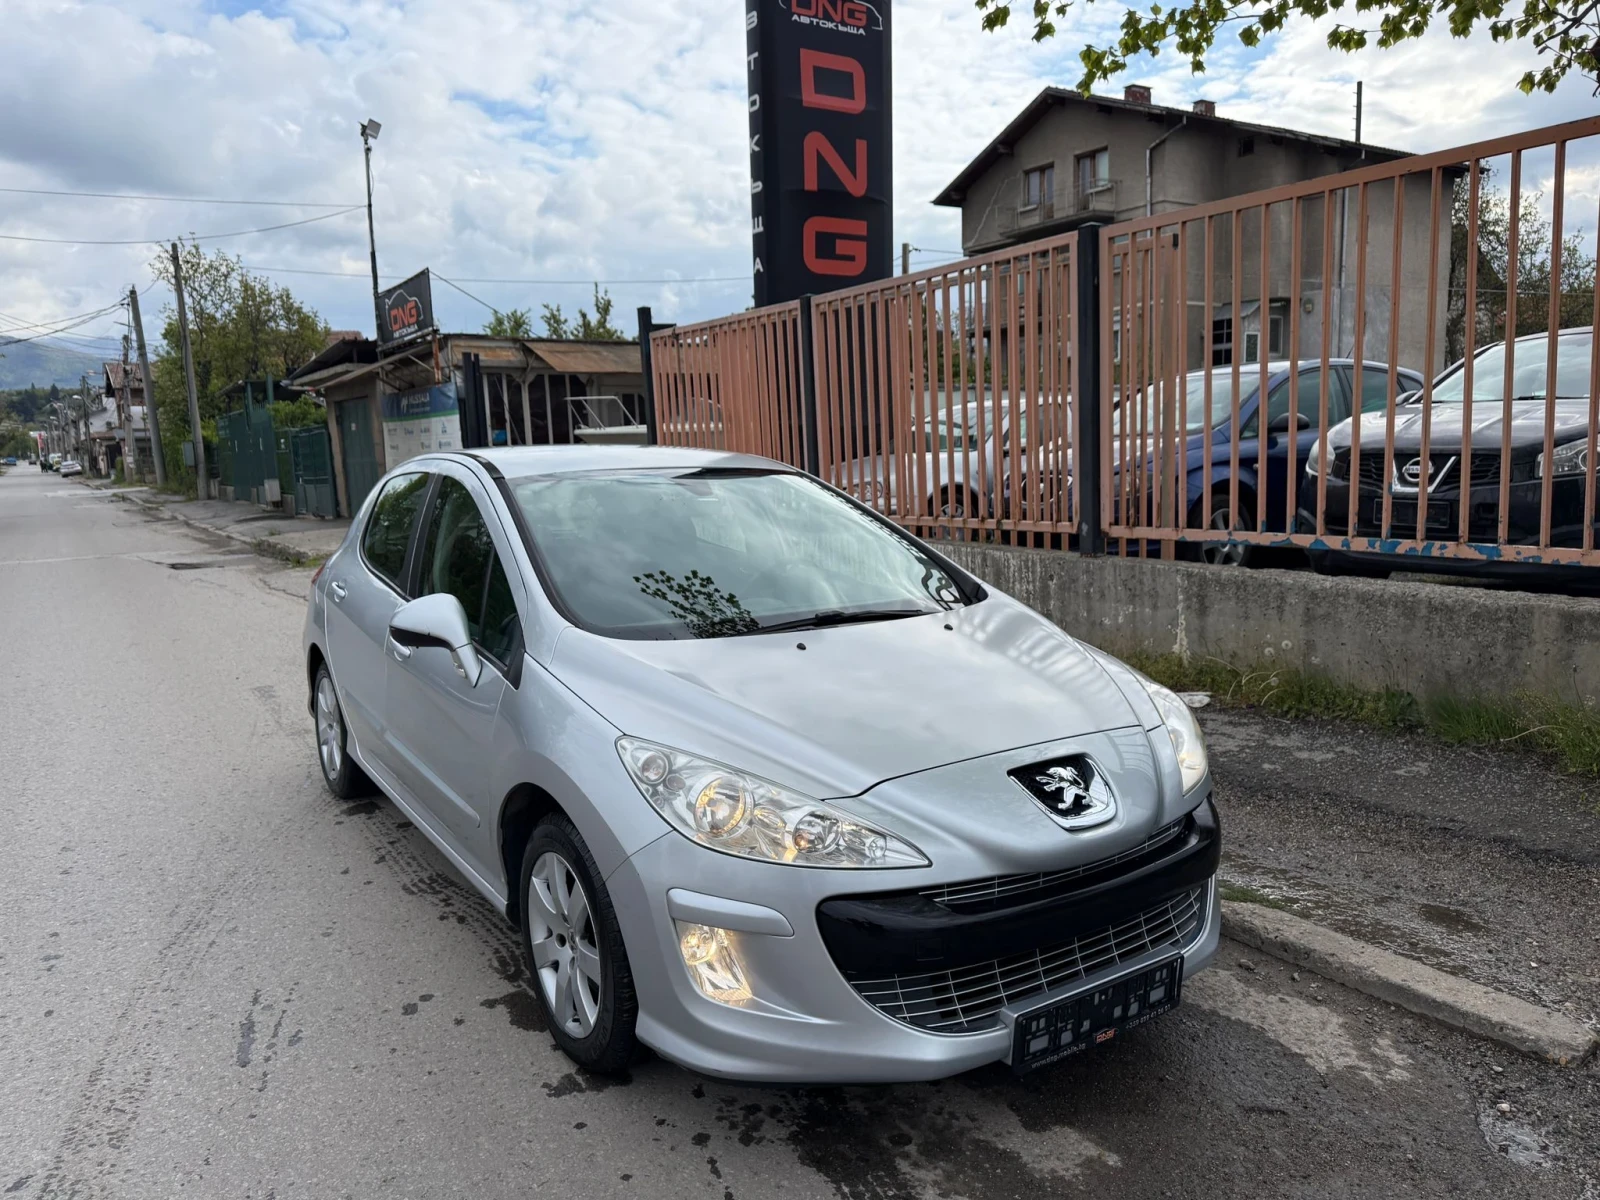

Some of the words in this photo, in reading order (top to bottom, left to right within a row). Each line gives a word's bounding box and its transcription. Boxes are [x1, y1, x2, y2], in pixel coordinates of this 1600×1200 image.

[791, 14, 866, 36] АВТОКЪЩА
[799, 47, 868, 277] DNG
[390, 300, 418, 332] DNG
